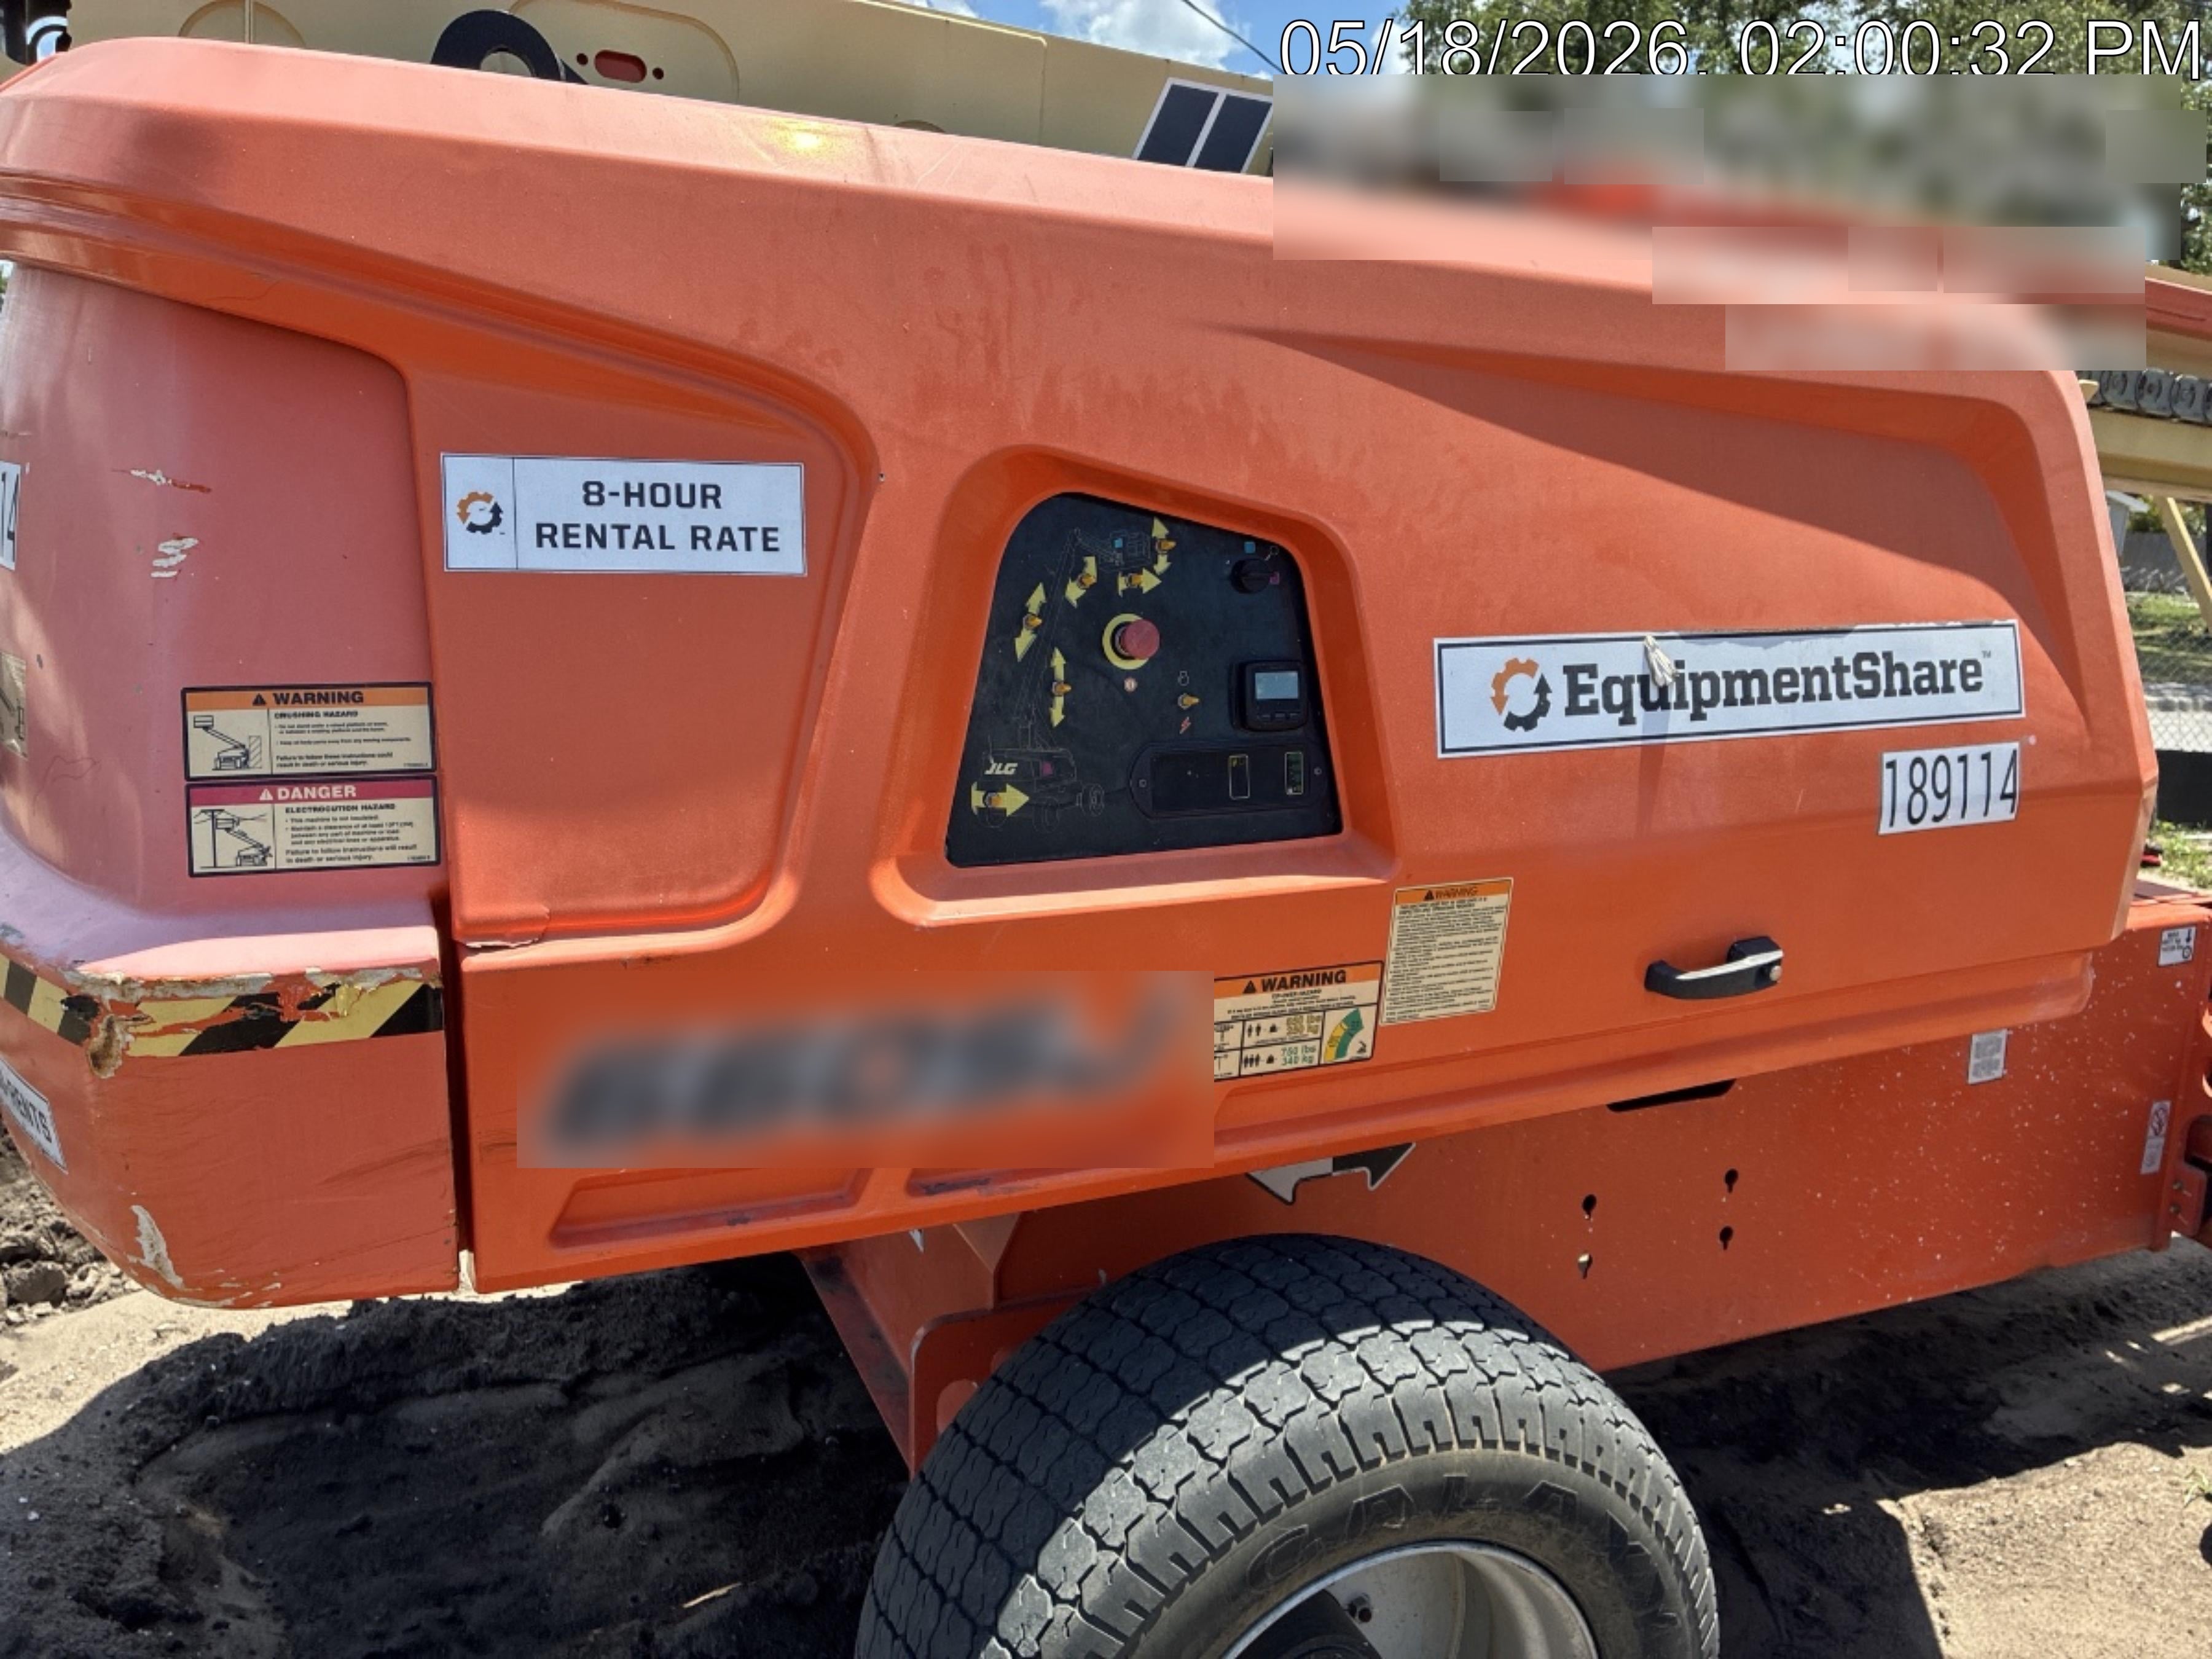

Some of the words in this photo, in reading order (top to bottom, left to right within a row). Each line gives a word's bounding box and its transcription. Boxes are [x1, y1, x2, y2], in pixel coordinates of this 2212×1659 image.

[582, 480, 722, 509] 8-HOUR
[535, 522, 675, 550] RENTAL
[690, 526, 780, 552] RATE
[272, 690, 364, 705] WARNING
[1563, 650, 1983, 726] EquipmentShare
[984, 762, 1018, 775] JLG
[278, 785, 356, 799] DANGER
[1885, 749, 2017, 828] 189114
[1261, 970, 1347, 992] WARNING
